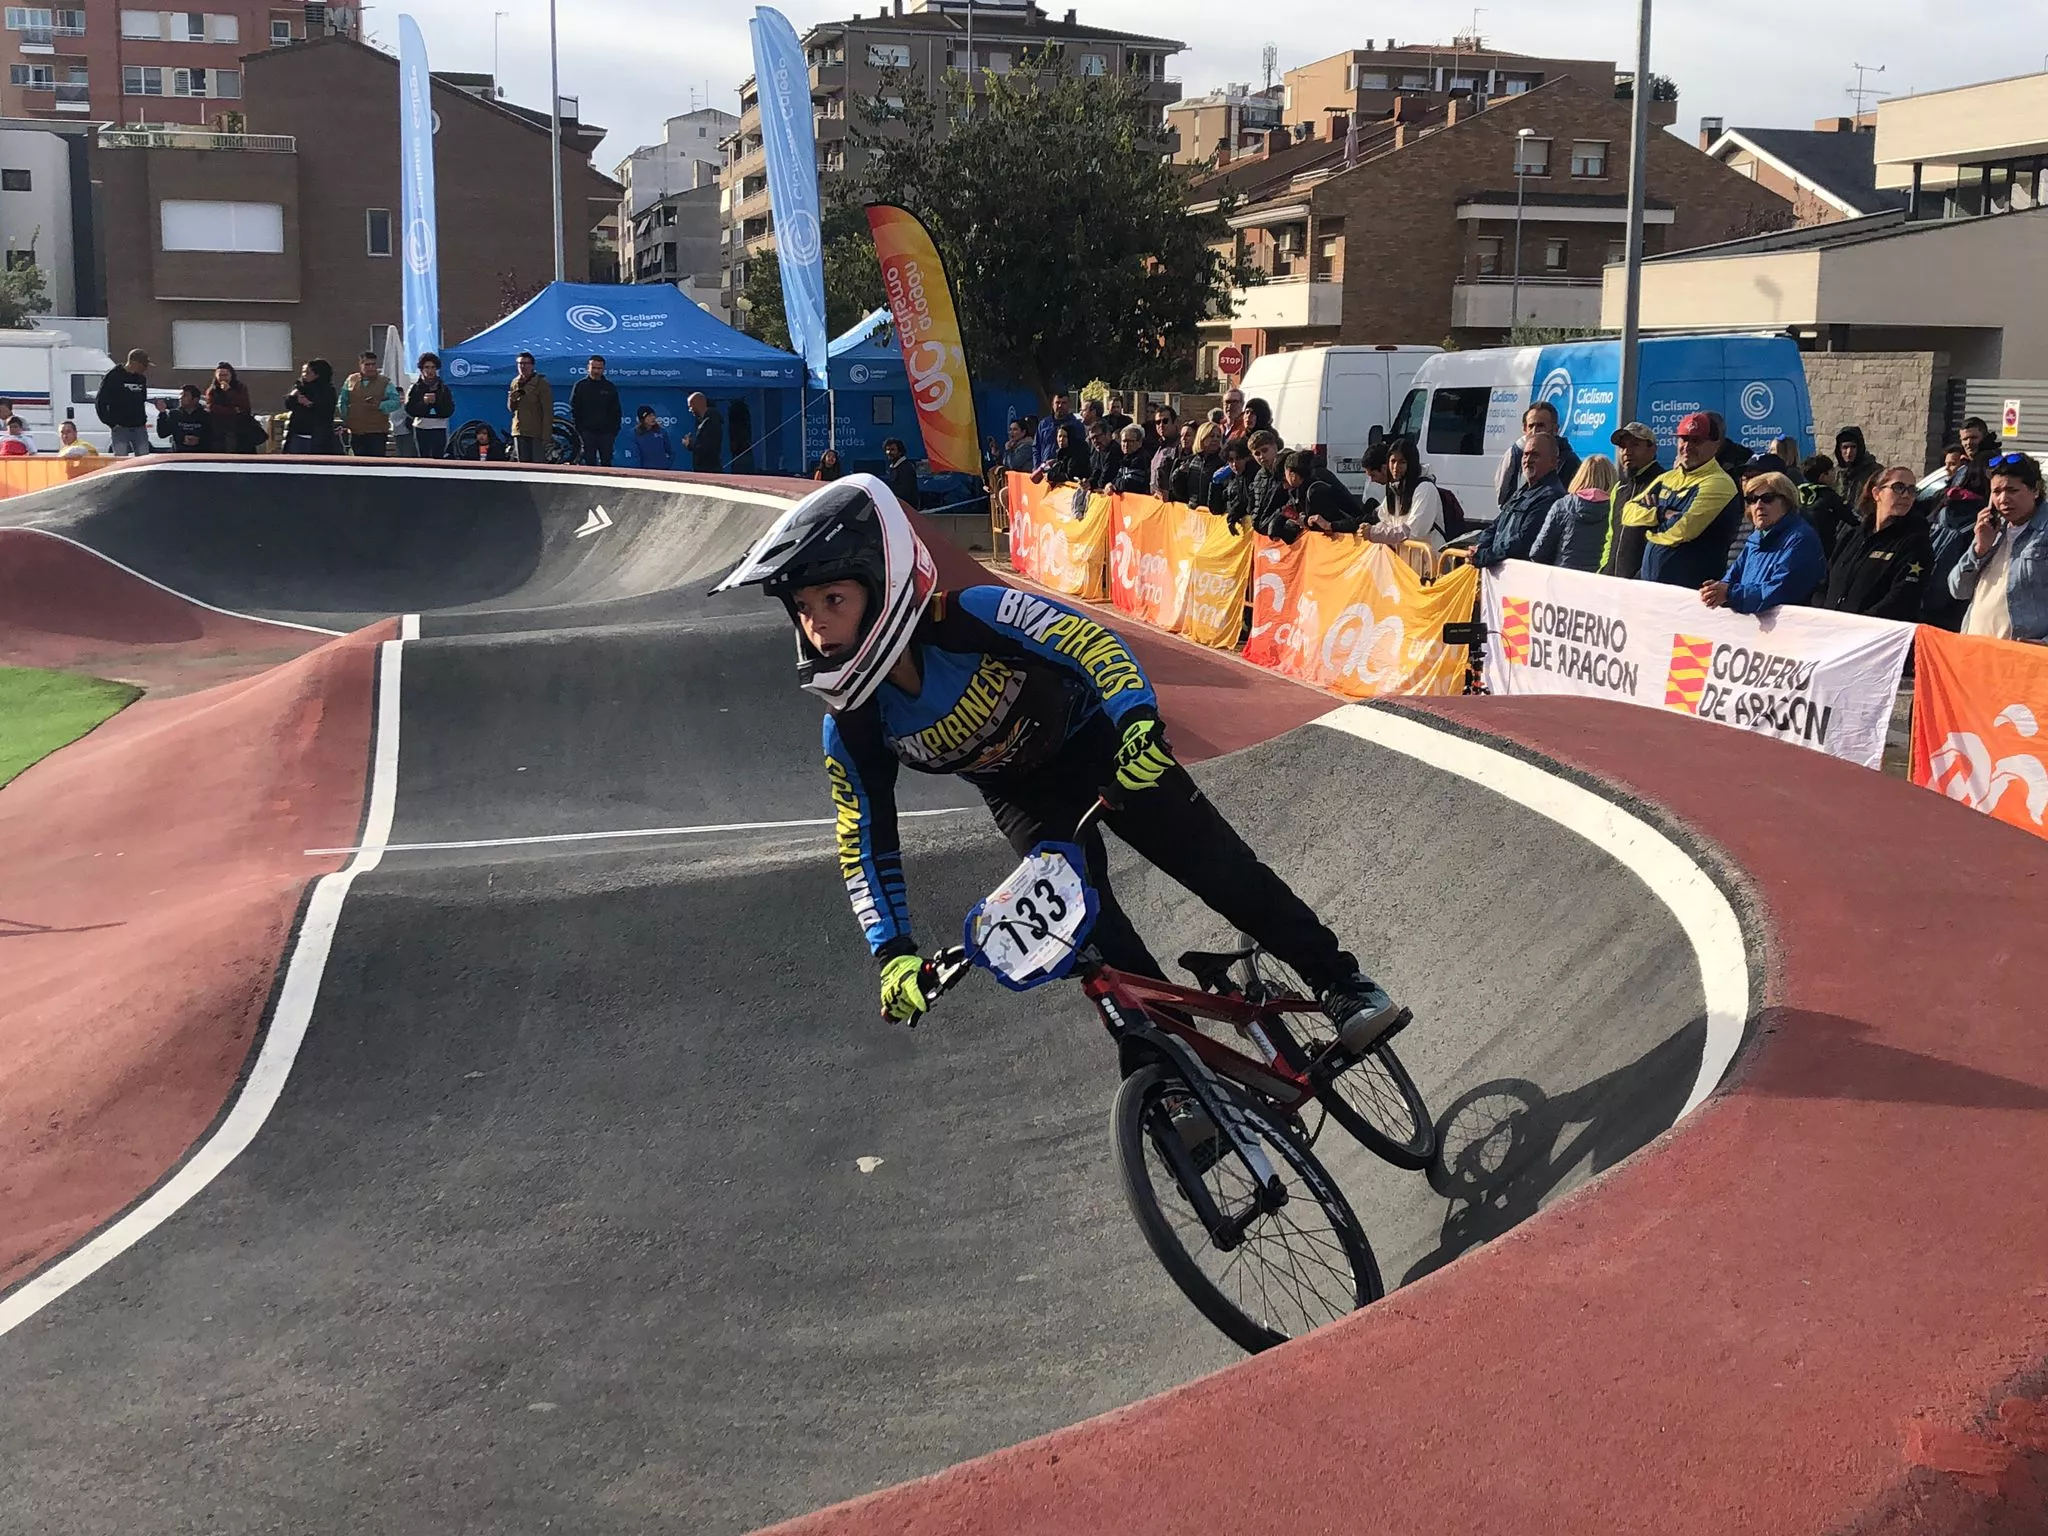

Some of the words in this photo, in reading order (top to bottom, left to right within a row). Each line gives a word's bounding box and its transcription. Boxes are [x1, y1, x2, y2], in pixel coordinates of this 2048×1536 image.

[621, 313, 668, 321] Ciclismo
[1220, 356, 1241, 364] STOP
[1577, 388, 1614, 404] Ciclismo
[1651, 400, 1700, 411] Ciclismo
[806, 414, 851, 424] Ciclimo
[1573, 409, 1606, 429] Galego
[1652, 414, 1667, 422] no
[1652, 424, 1673, 435] dos
[1741, 424, 1782, 435] Ciclismo
[1741, 438, 1771, 449] Galeg
[1531, 600, 1628, 653] GOBIERNO
[1530, 637, 1553, 673] DE
[1557, 646, 1639, 697] ARAGON
[1712, 643, 1821, 691] GOBIERNO
[1699, 683, 1734, 723] DE
[1735, 692, 1832, 746] ARAGON
[1118, 733, 1149, 766] FOX
[1000, 878, 1067, 957] 133
